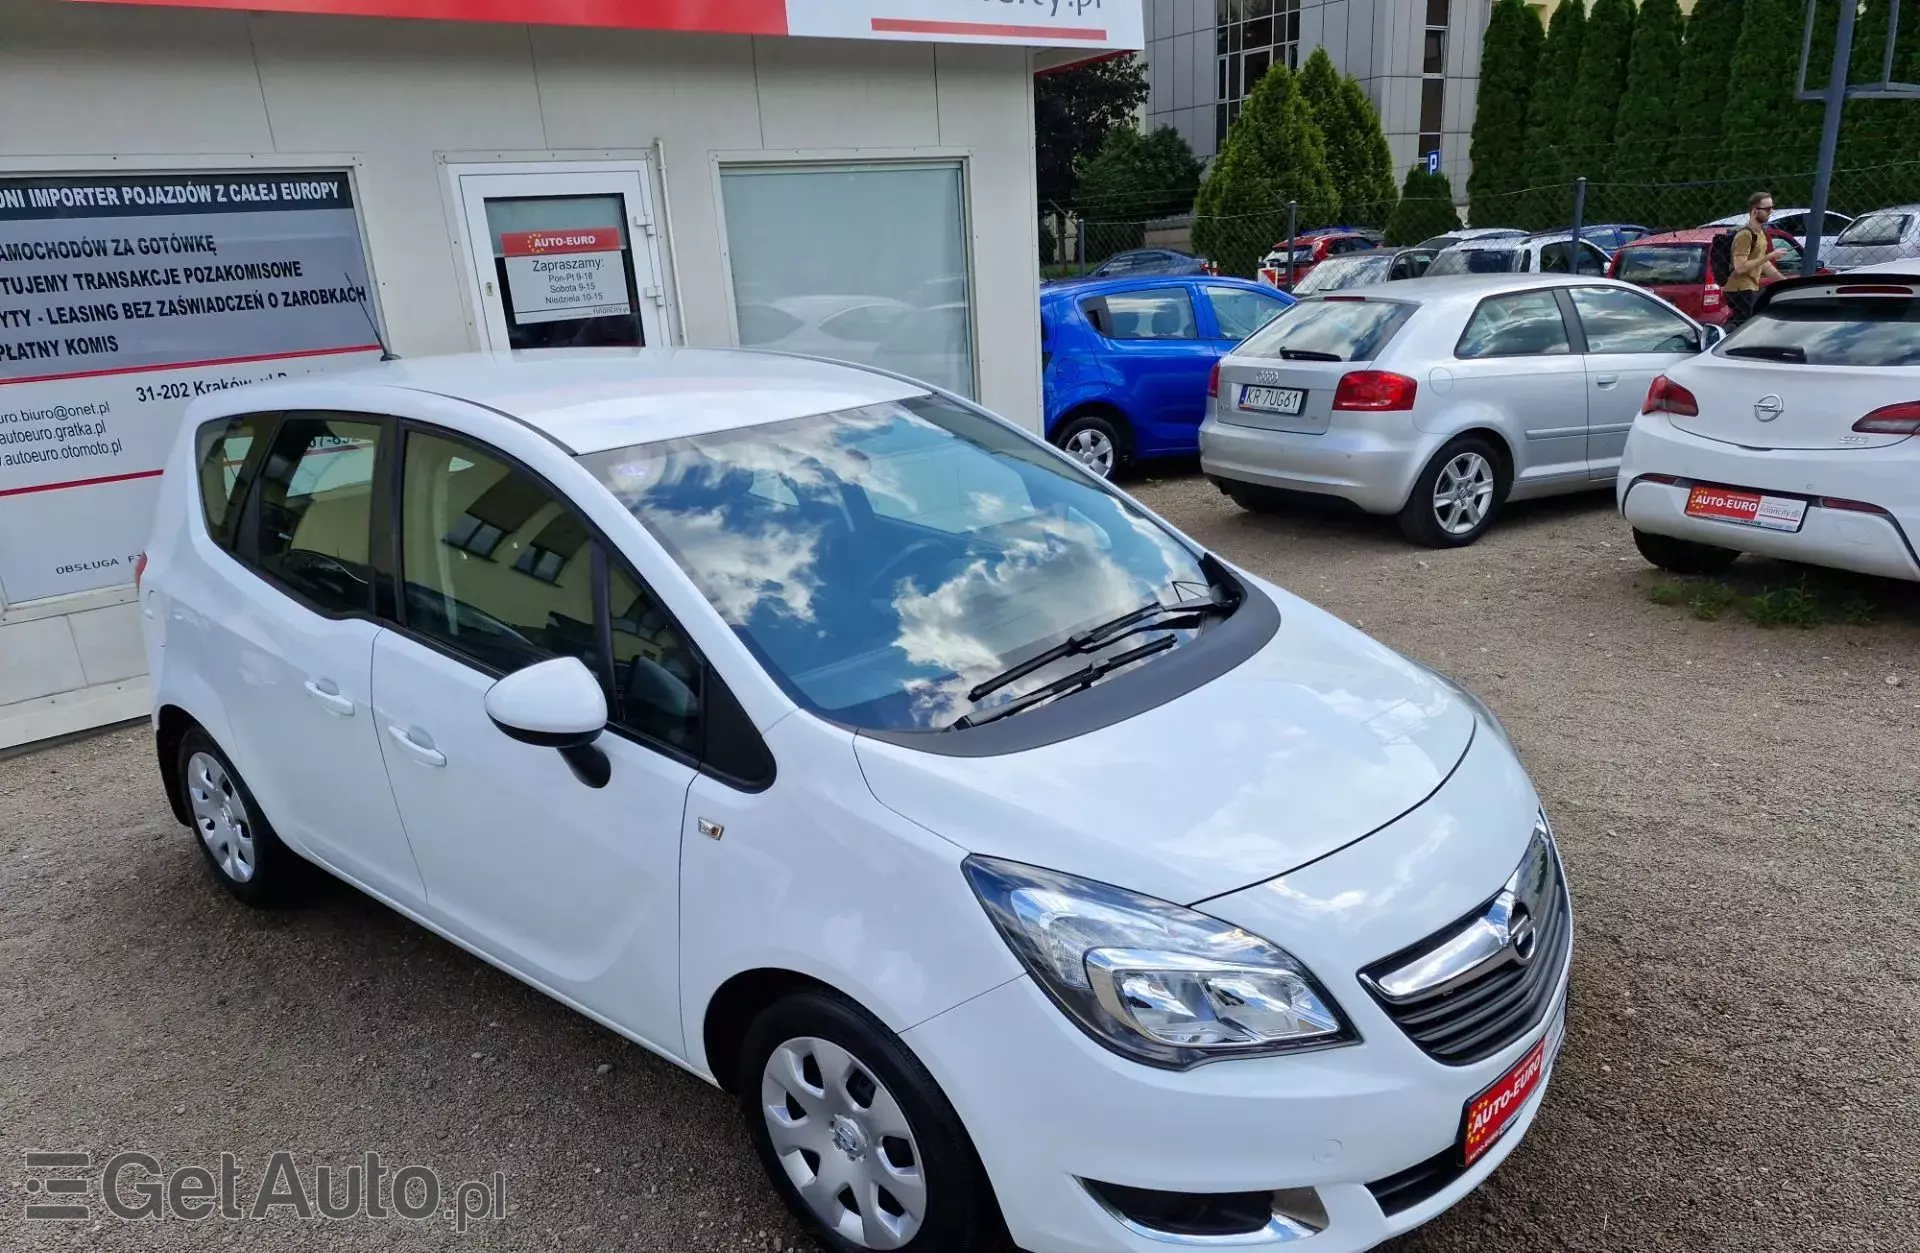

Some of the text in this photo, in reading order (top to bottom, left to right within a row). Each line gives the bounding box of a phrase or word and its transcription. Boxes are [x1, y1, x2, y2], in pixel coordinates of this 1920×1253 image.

[1430, 153, 1438, 176] P
[28, 187, 120, 207] IMPORTER
[121, 181, 212, 205] POJAZDÓW
[214, 184, 227, 202] Z
[229, 183, 277, 202] CAŁEJ
[280, 182, 338, 200] EUROPY
[111, 239, 136, 256] ZA
[137, 232, 217, 256] GOTÓWKĘ
[534, 235, 596, 247] AUTO-EURO
[0, 261, 303, 295] TUJEMY TRANSAKCJE POZAKOMISOWE
[550, 282, 596, 294] Sobota 9-15
[46, 303, 119, 325] LEASING
[121, 300, 155, 319] BEZ
[156, 290, 265, 316] ZAŚWIADCZEŃ
[268, 292, 278, 308] O
[281, 286, 367, 307] ZAROBKACH
[545, 292, 603, 304] Niedziela 10-15
[65, 335, 119, 355] KOMIS
[136, 382, 190, 402] 31-202
[1246, 387, 1299, 408] KR 7UG61
[0, 420, 107, 445] autoeuro.gratka.pl
[0, 438, 123, 467] .autoeuro.otomoto.pl
[1695, 494, 1757, 512] AUTO-EURO
[56, 558, 120, 574] OBSŁUGA
[1472, 1054, 1541, 1133] AUTO-EURO
